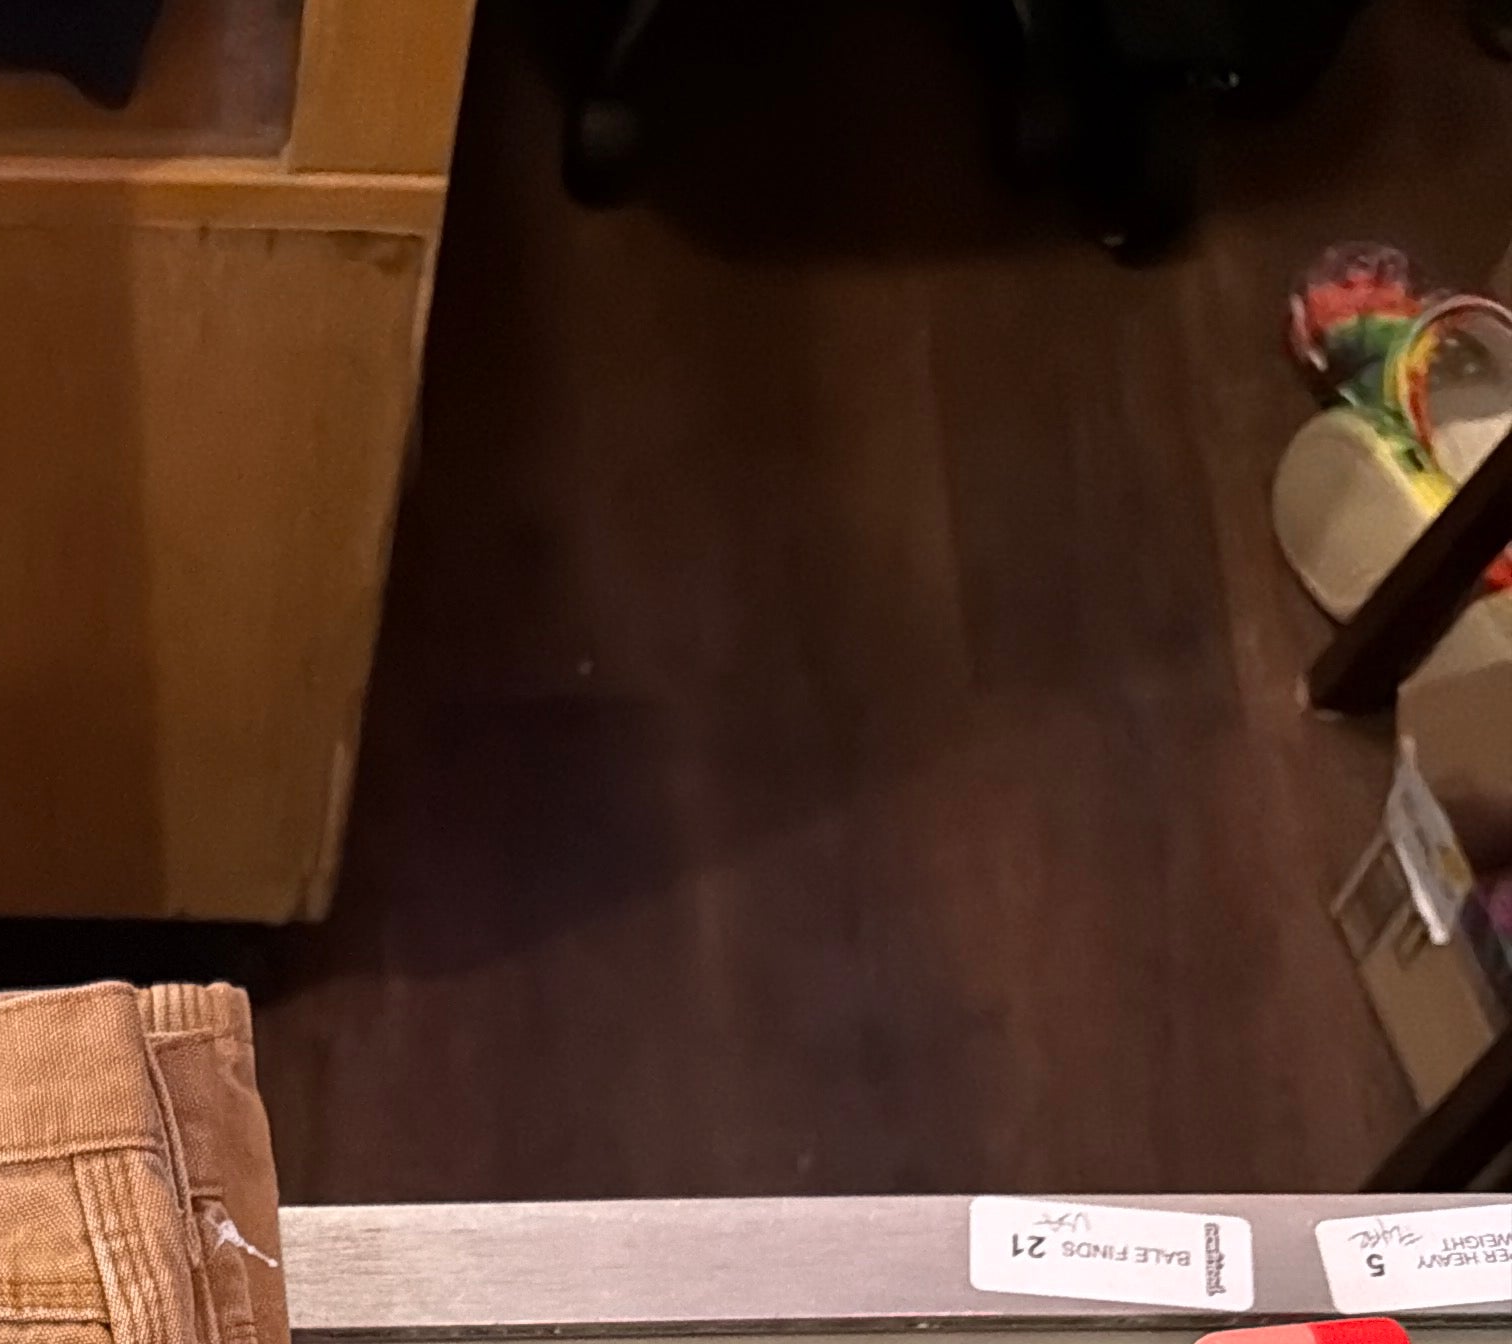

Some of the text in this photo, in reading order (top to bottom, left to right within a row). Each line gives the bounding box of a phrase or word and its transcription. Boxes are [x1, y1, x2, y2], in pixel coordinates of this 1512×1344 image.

[1011, 1232, 1191, 1267] BALE FINDS 21
[1417, 1247, 1512, 1270] ER HEAVY
[1365, 1253, 1386, 1278] 5
